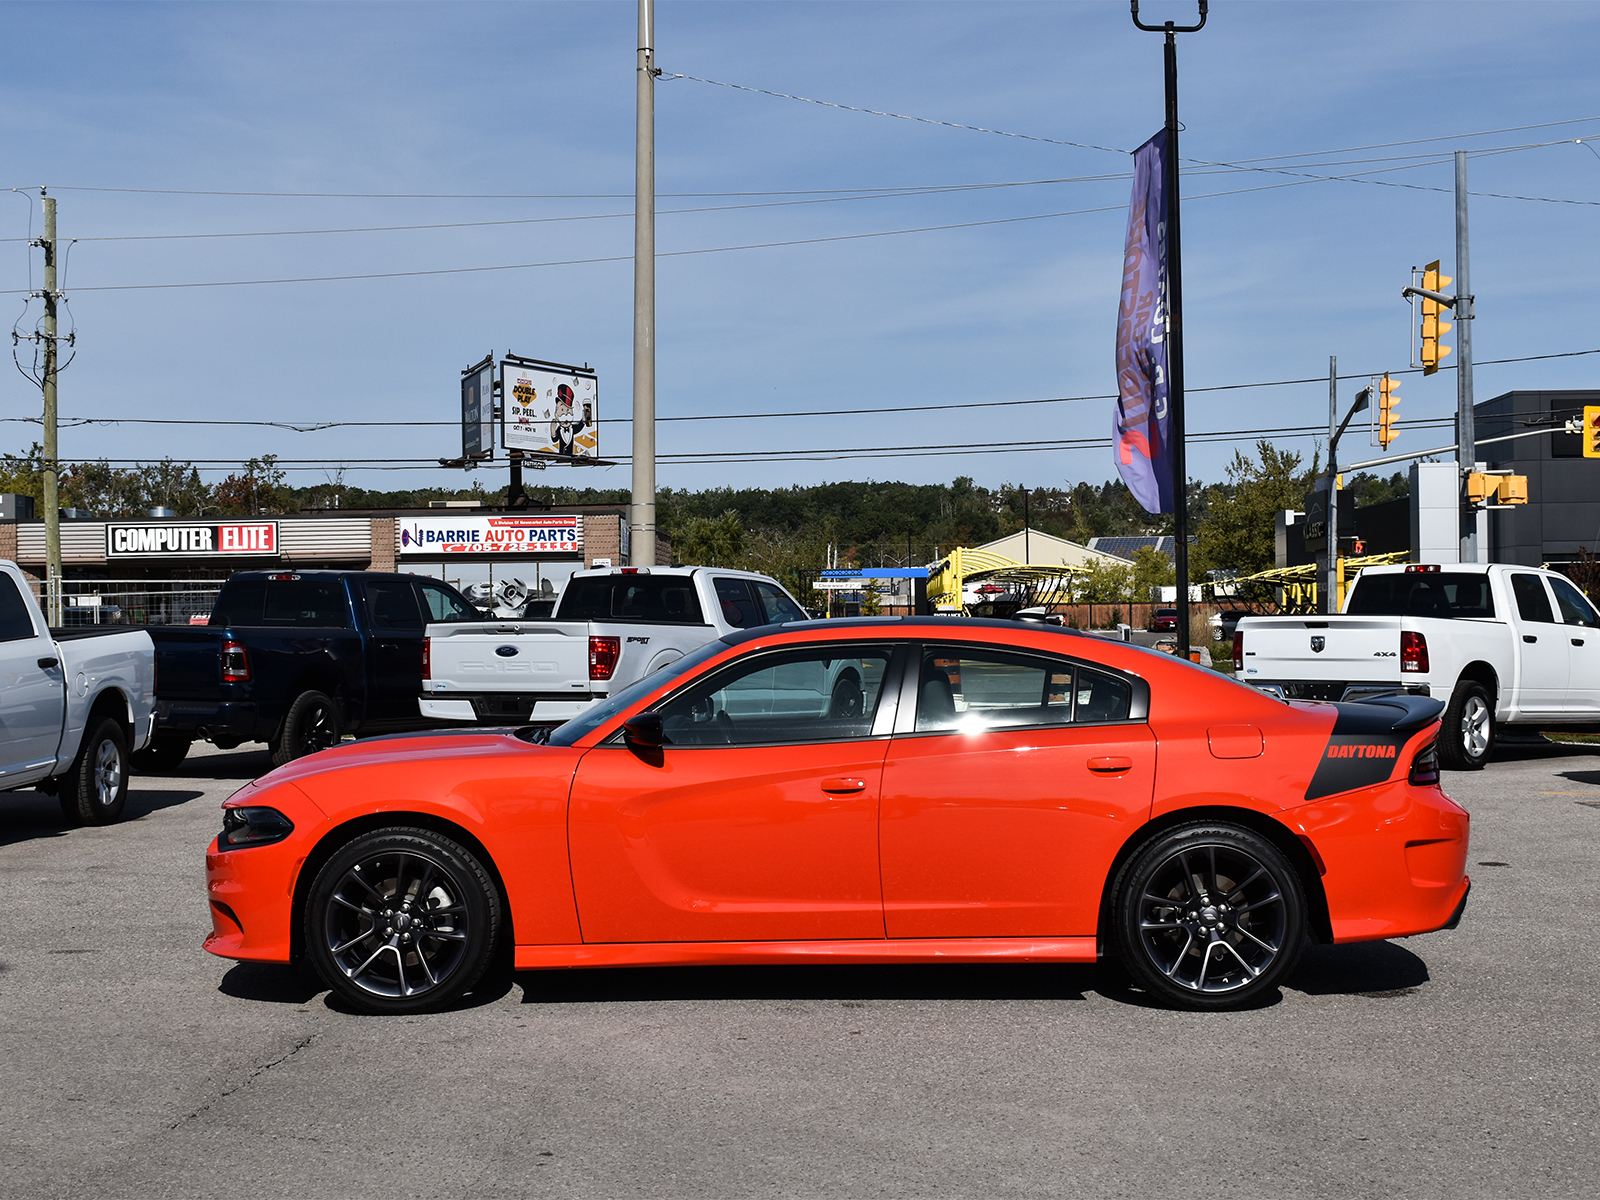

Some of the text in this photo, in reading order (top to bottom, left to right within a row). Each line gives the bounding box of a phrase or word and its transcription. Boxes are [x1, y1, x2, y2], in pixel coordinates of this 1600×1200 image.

[513, 385, 536, 396] DOUBLE
[517, 394, 532, 404] PLAY
[114, 526, 269, 552] COMPUTER ELITE
[426, 528, 576, 543] BARRIE AUTO PARTS
[463, 542, 574, 552] 705-725-1114
[171, 571, 210, 580] COMPUTER
[173, 593, 204, 601] EPSON
[626, 636, 650, 644] SPORT
[456, 661, 560, 674] F-150
[1327, 745, 1396, 758] DAYTONA
